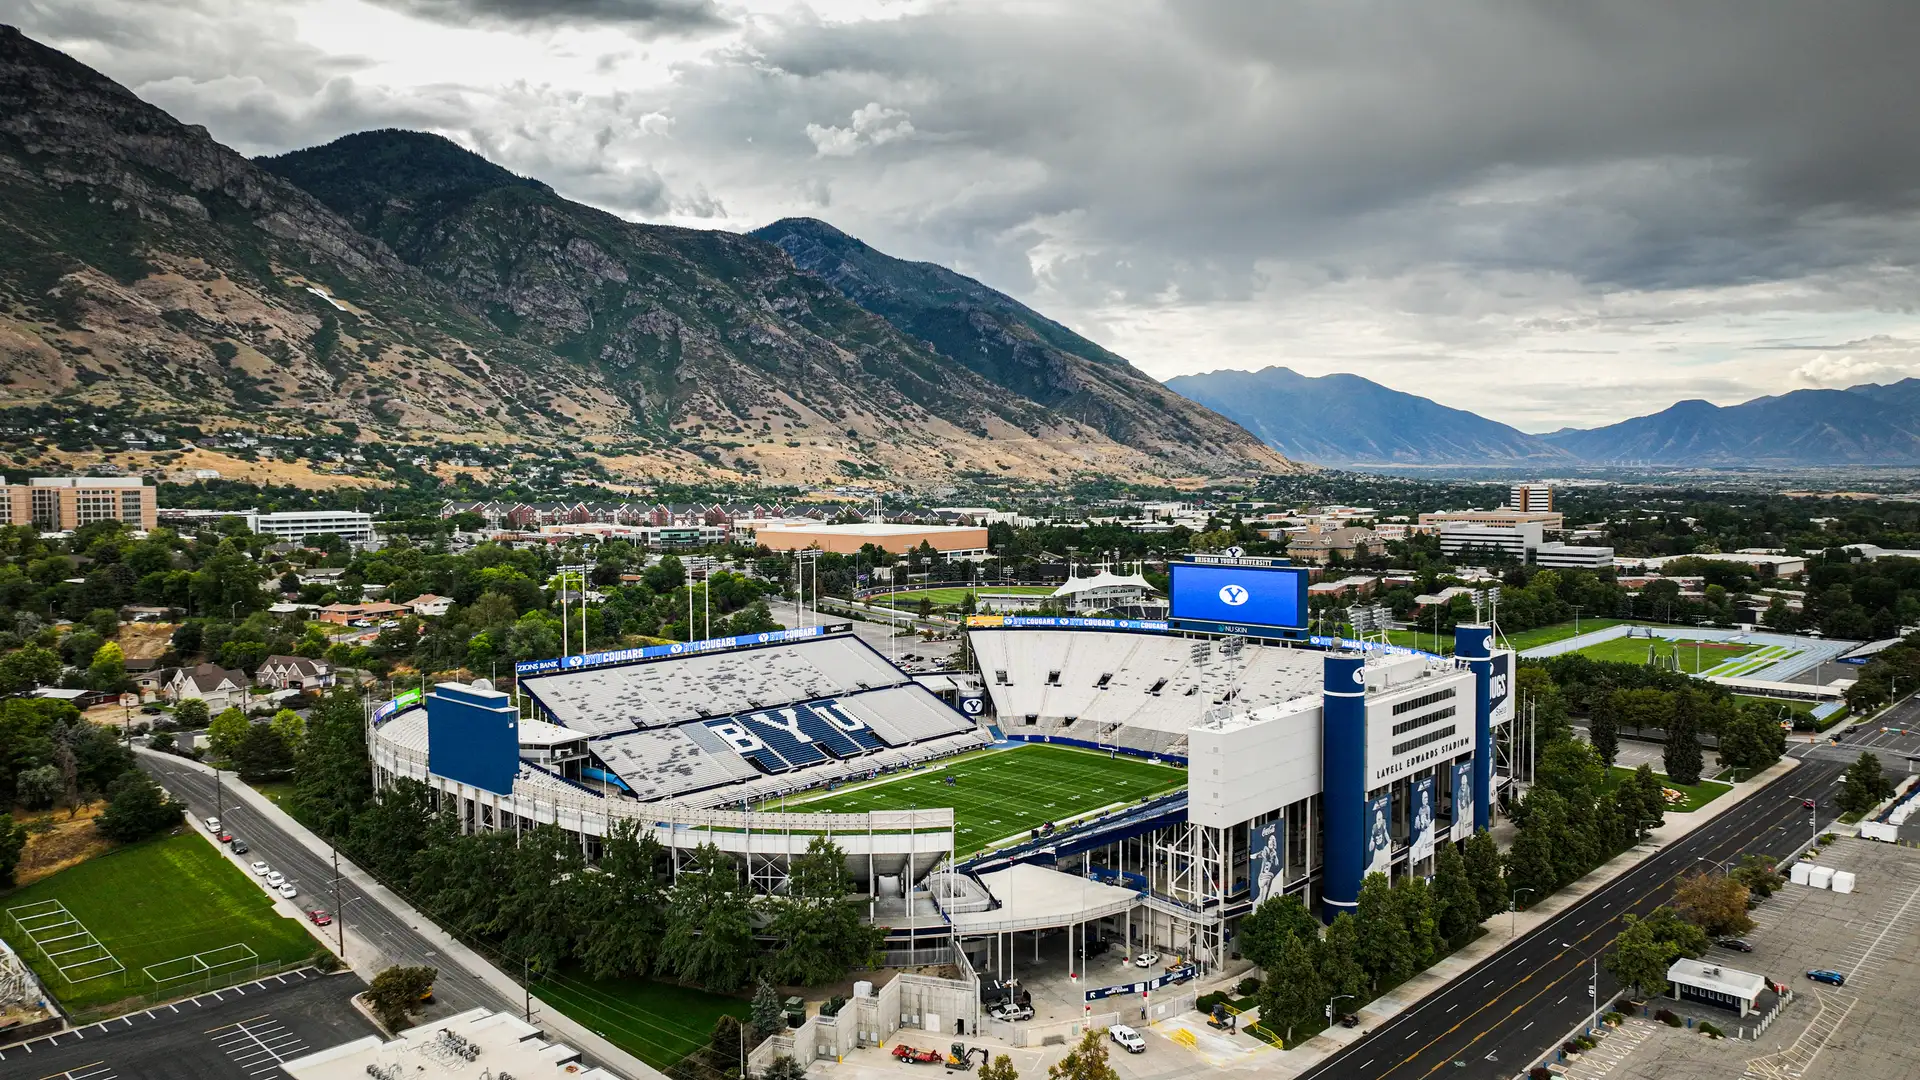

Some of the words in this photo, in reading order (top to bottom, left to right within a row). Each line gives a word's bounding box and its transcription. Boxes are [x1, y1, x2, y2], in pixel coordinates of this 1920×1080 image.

[1194, 556, 1218, 564] BRIGHAM
[1225, 587, 1243, 602] Y
[1083, 618, 1115, 627] COUGARS
[1140, 621, 1168, 630] COUGARS
[784, 627, 817, 639] COUGARS
[1235, 626, 1248, 634] SKIN
[700, 637, 737, 650] COUGARS
[583, 653, 602, 666] BYU
[603, 648, 643, 662] COUGARS
[517, 663, 539, 672] ZIONS
[539, 660, 559, 669] BANK
[708, 703, 865, 753] BYU
[1376, 762, 1403, 780] LAVELL
[1406, 748, 1438, 768] EDWARDS
[1441, 736, 1470, 754] STADIUM
